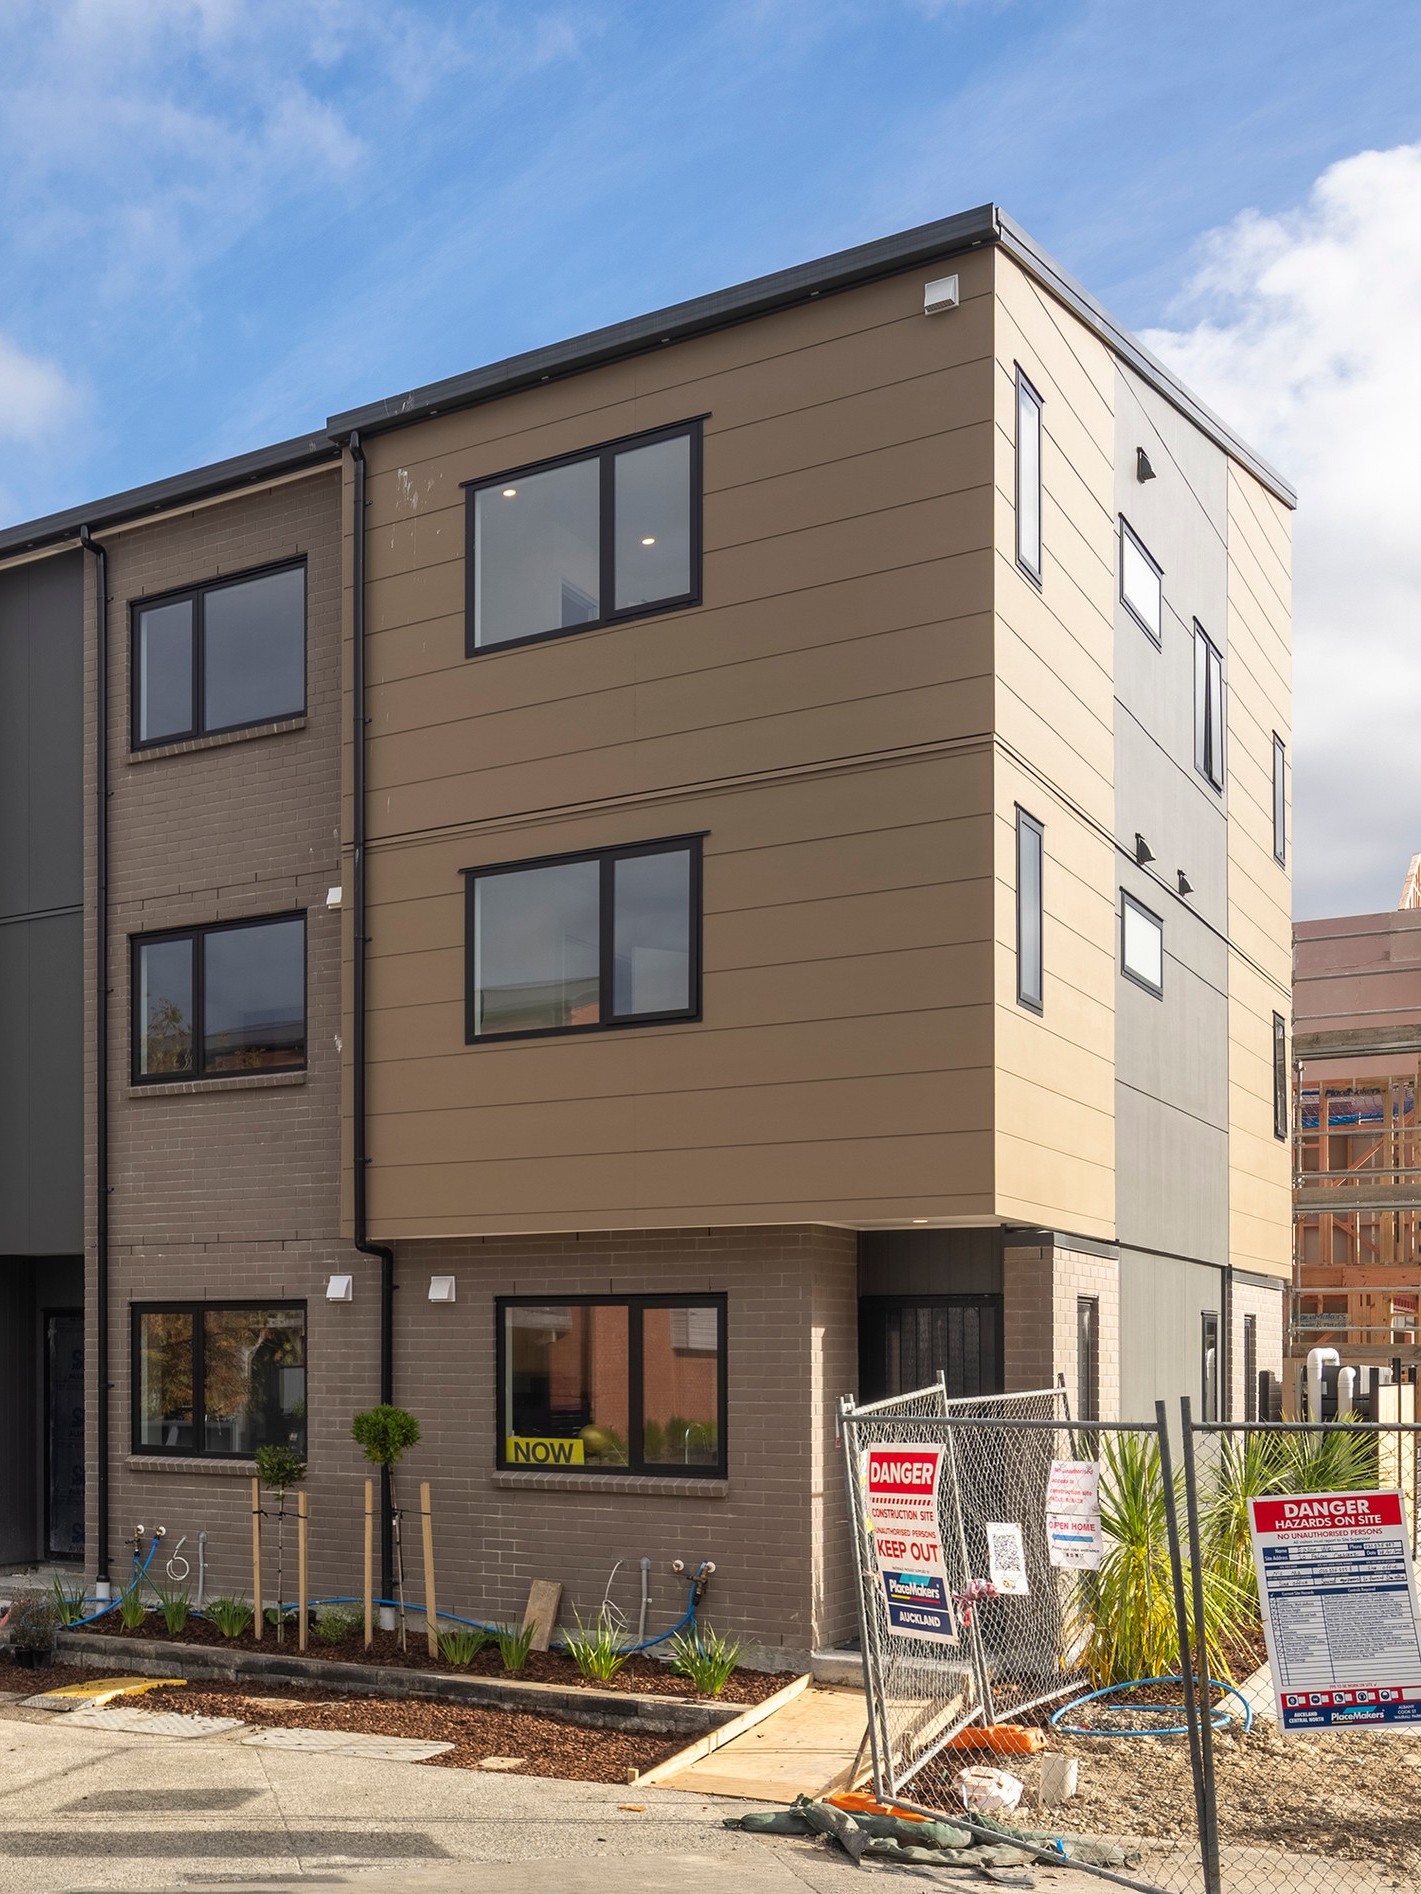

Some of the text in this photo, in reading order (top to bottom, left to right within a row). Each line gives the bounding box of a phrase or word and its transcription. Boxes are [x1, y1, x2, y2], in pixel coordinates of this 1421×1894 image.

[514, 1442, 574, 1463] NOW
[871, 1462, 934, 1484] DANGER
[872, 1508, 934, 1521] CONSTRUCTION SITE
[1283, 1500, 1370, 1518] DANGER
[1049, 1521, 1095, 1531] OPEN HOME
[1275, 1514, 1382, 1529] HAZARDS ON SITE
[875, 1527, 936, 1538] UNAUTHORISED PERSONS
[1291, 1530, 1348, 1539] UNAUTHORISED
[1350, 1528, 1382, 1536] PERSONS
[877, 1539, 938, 1562] KEEP OUT
[889, 1579, 939, 1598] PlaceMakers
[900, 1611, 941, 1627] AUCKLAND
[1331, 1711, 1384, 1721] PlaceMakers
